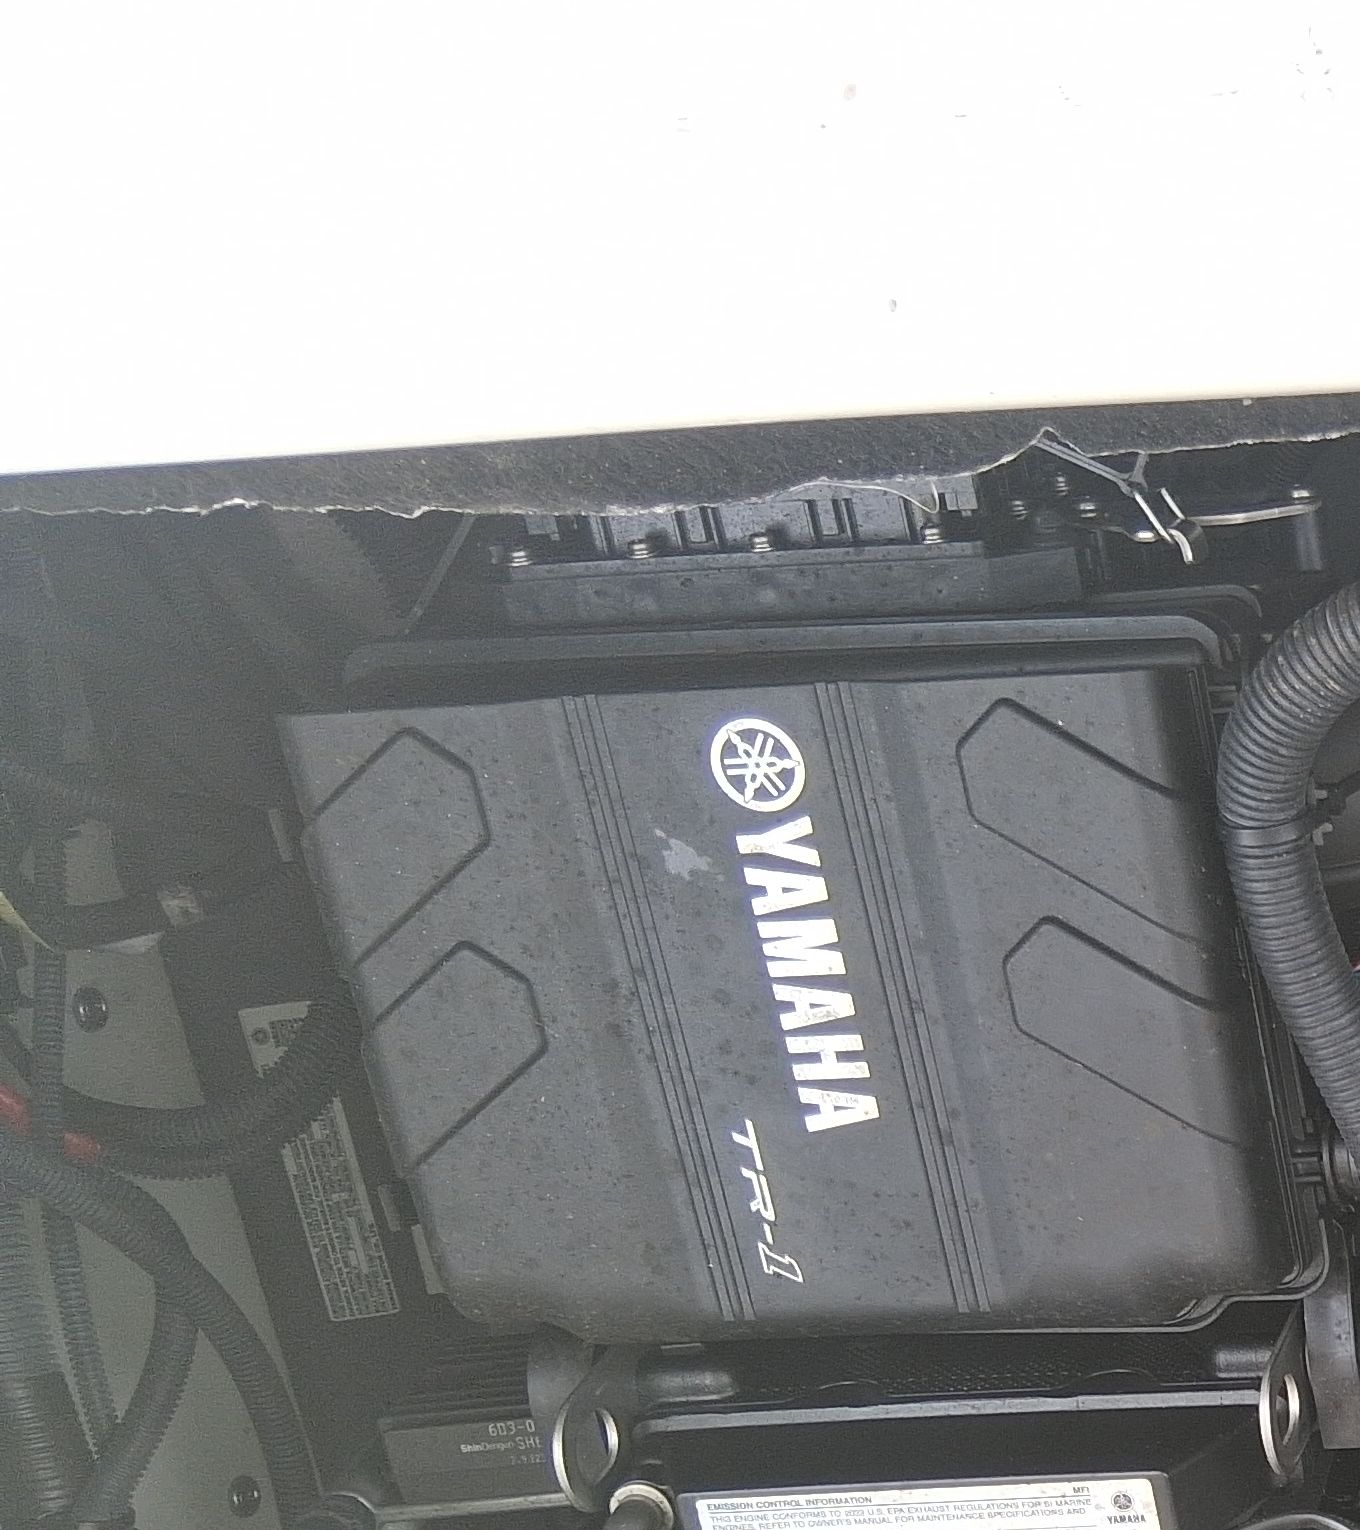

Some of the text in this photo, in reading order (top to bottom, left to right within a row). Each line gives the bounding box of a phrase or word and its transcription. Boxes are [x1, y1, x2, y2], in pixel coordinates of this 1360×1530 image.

[735, 814, 880, 1134] YAMAHA
[729, 1116, 804, 1284] TR-1
[706, 1495, 872, 1511] EMISSION CONTROL INFORMATION
[709, 1515, 731, 1523] THIS
[733, 1513, 770, 1522] ENGINE
[771, 1510, 827, 1520] CONFORMS
[828, 1509, 842, 1518] TO
[886, 1506, 905, 1515] EPA
[906, 1504, 950, 1514] EXHAUST
[952, 1501, 1019, 1511] REGULATIONS
[1020, 1500, 1041, 1508] FOR
[1054, 1497, 1091, 1507] MARINE
[757, 1521, 791, 1530] REFER
[792, 1520, 806, 1528] TO
[806, 1518, 852, 1528] OWNER'S
[853, 1516, 894, 1525] MANUAL
[893, 1515, 915, 1523] FOR
[916, 1511, 985, 1522] MAINTENANCE
[986, 1507, 1064, 1519] SPECIFICATIONS
[1065, 1506, 1086, 1515] AND
[1106, 1513, 1146, 1524] YAMAHA
